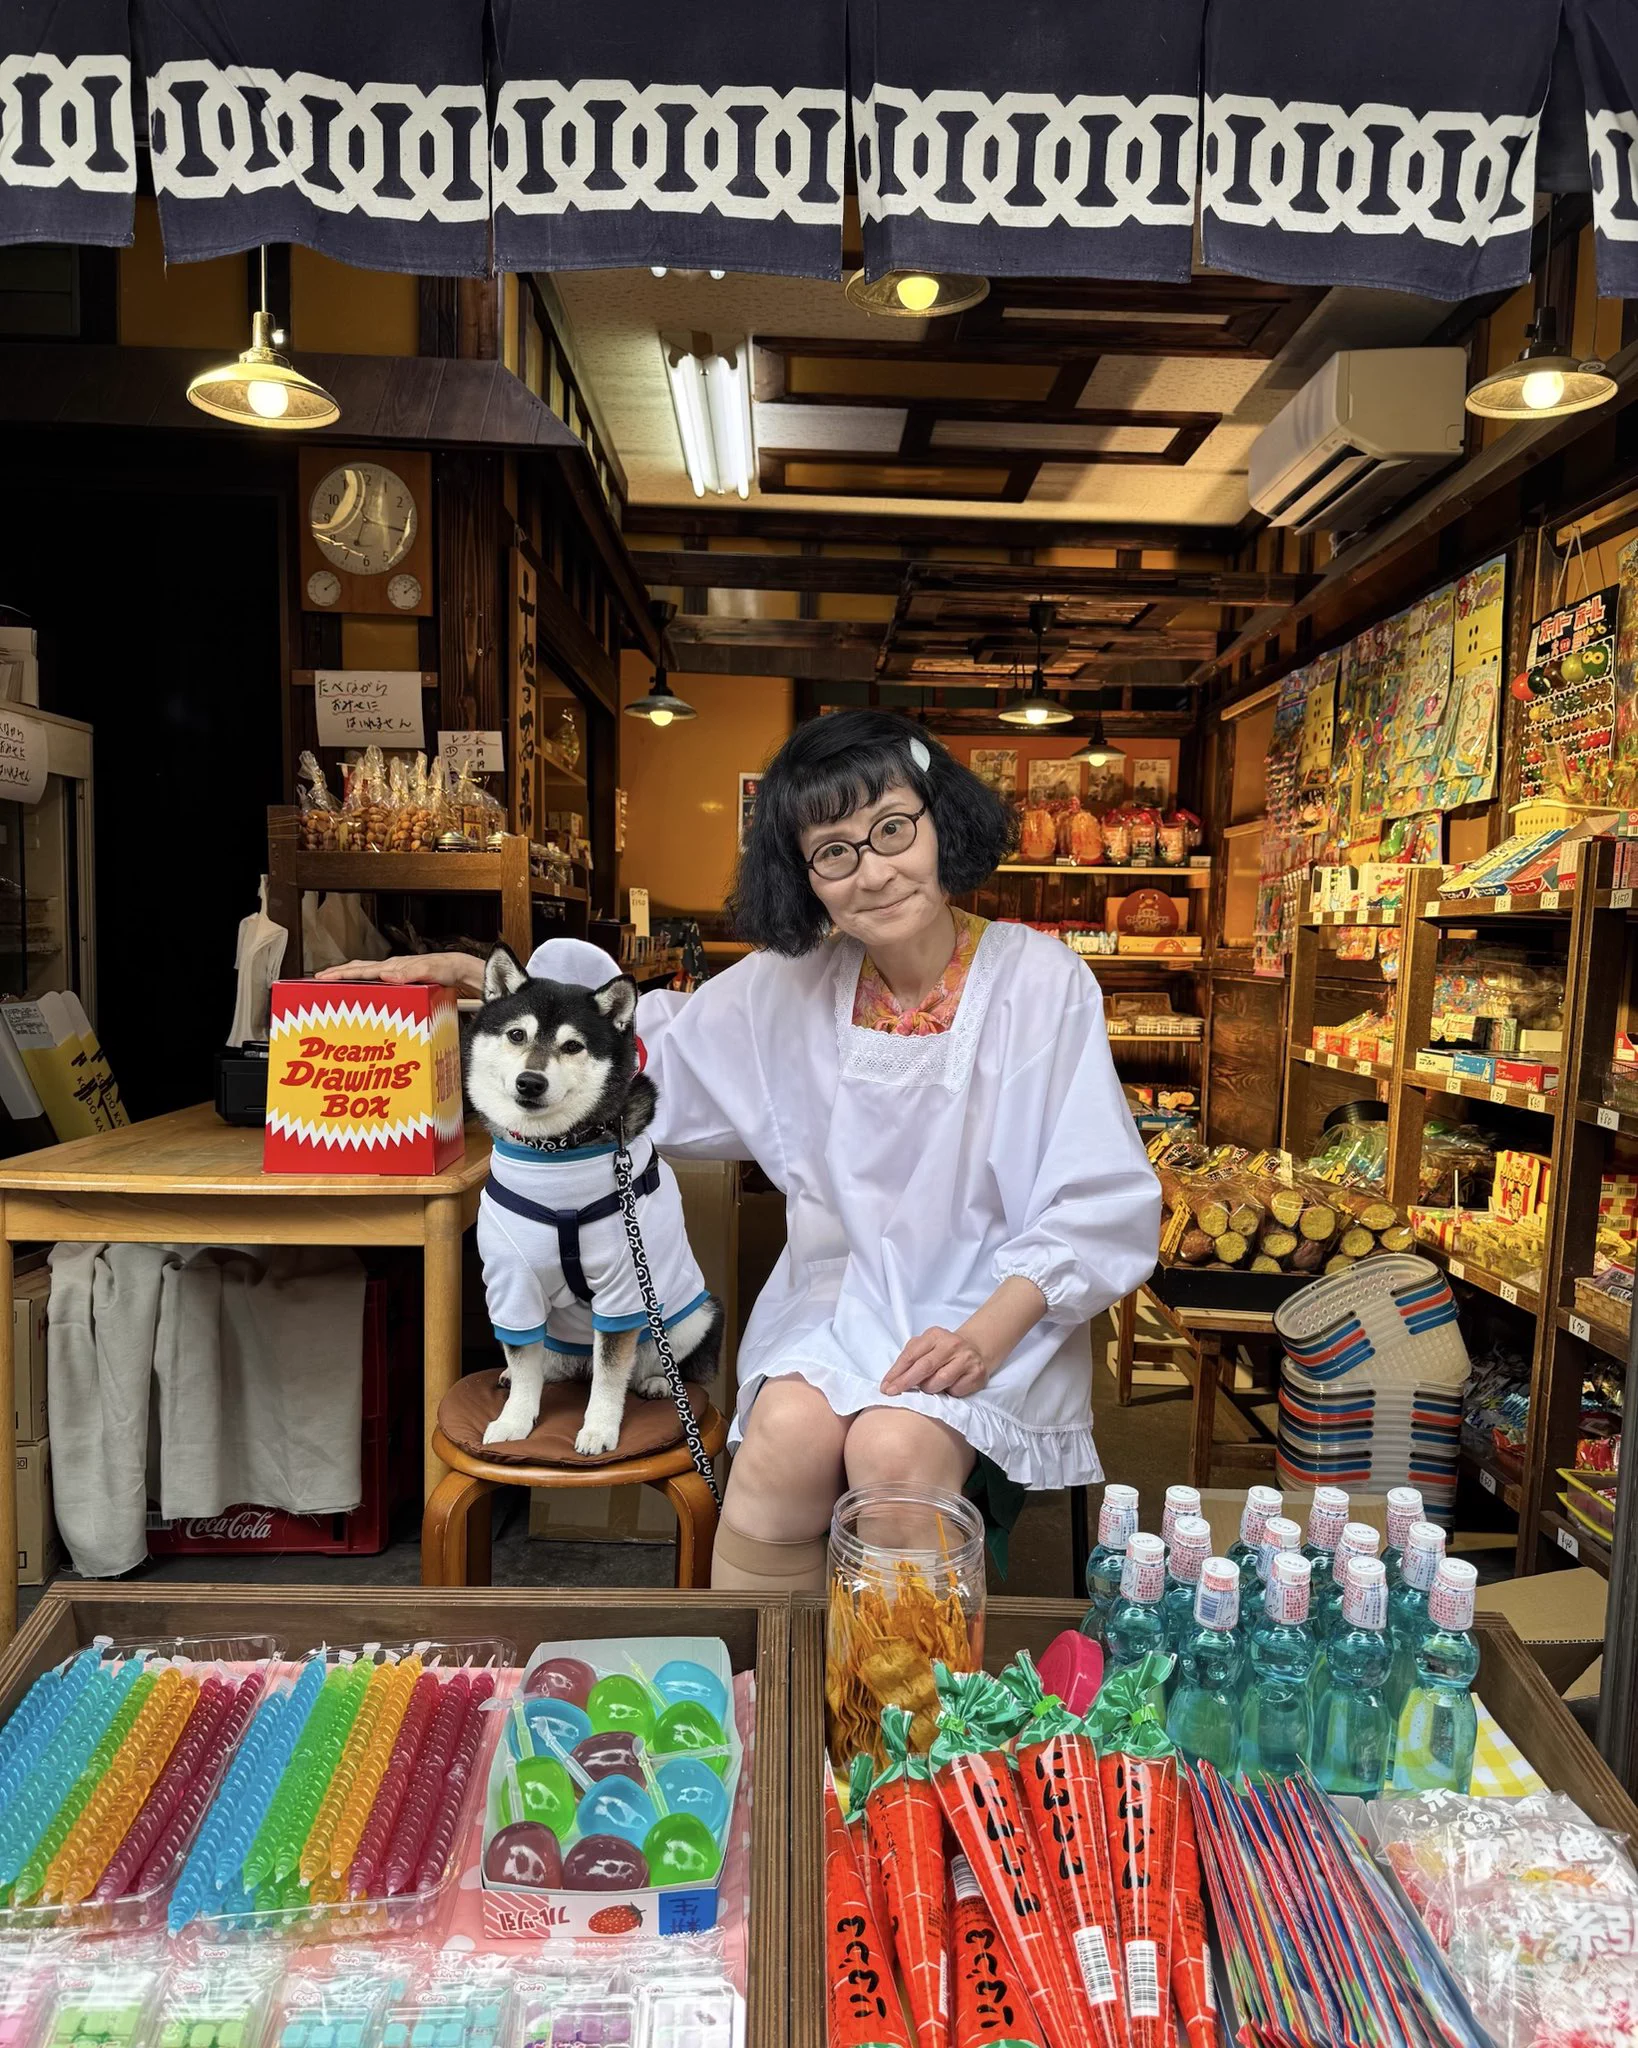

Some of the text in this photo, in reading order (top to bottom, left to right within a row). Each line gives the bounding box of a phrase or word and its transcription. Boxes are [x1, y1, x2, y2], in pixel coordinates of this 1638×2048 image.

[328, 494, 340, 506] 10
[396, 496, 403, 508] 2
[363, 555, 370, 567] 6
[317, 679, 388, 696] たべながら
[331, 699, 379, 711] おみせに
[1613, 893, 1630, 905] ¥150
[298, 1036, 397, 1064] Dream's
[279, 1060, 421, 1093] Drawing
[320, 1094, 391, 1119] Box
[1034, 1750, 1084, 1881] にんじん
[1116, 1762, 1156, 1890] にんじん
[972, 1777, 1042, 1918] にんじん
[836, 1914, 887, 2019] にんじん
[964, 1927, 1015, 2029] にんじん
